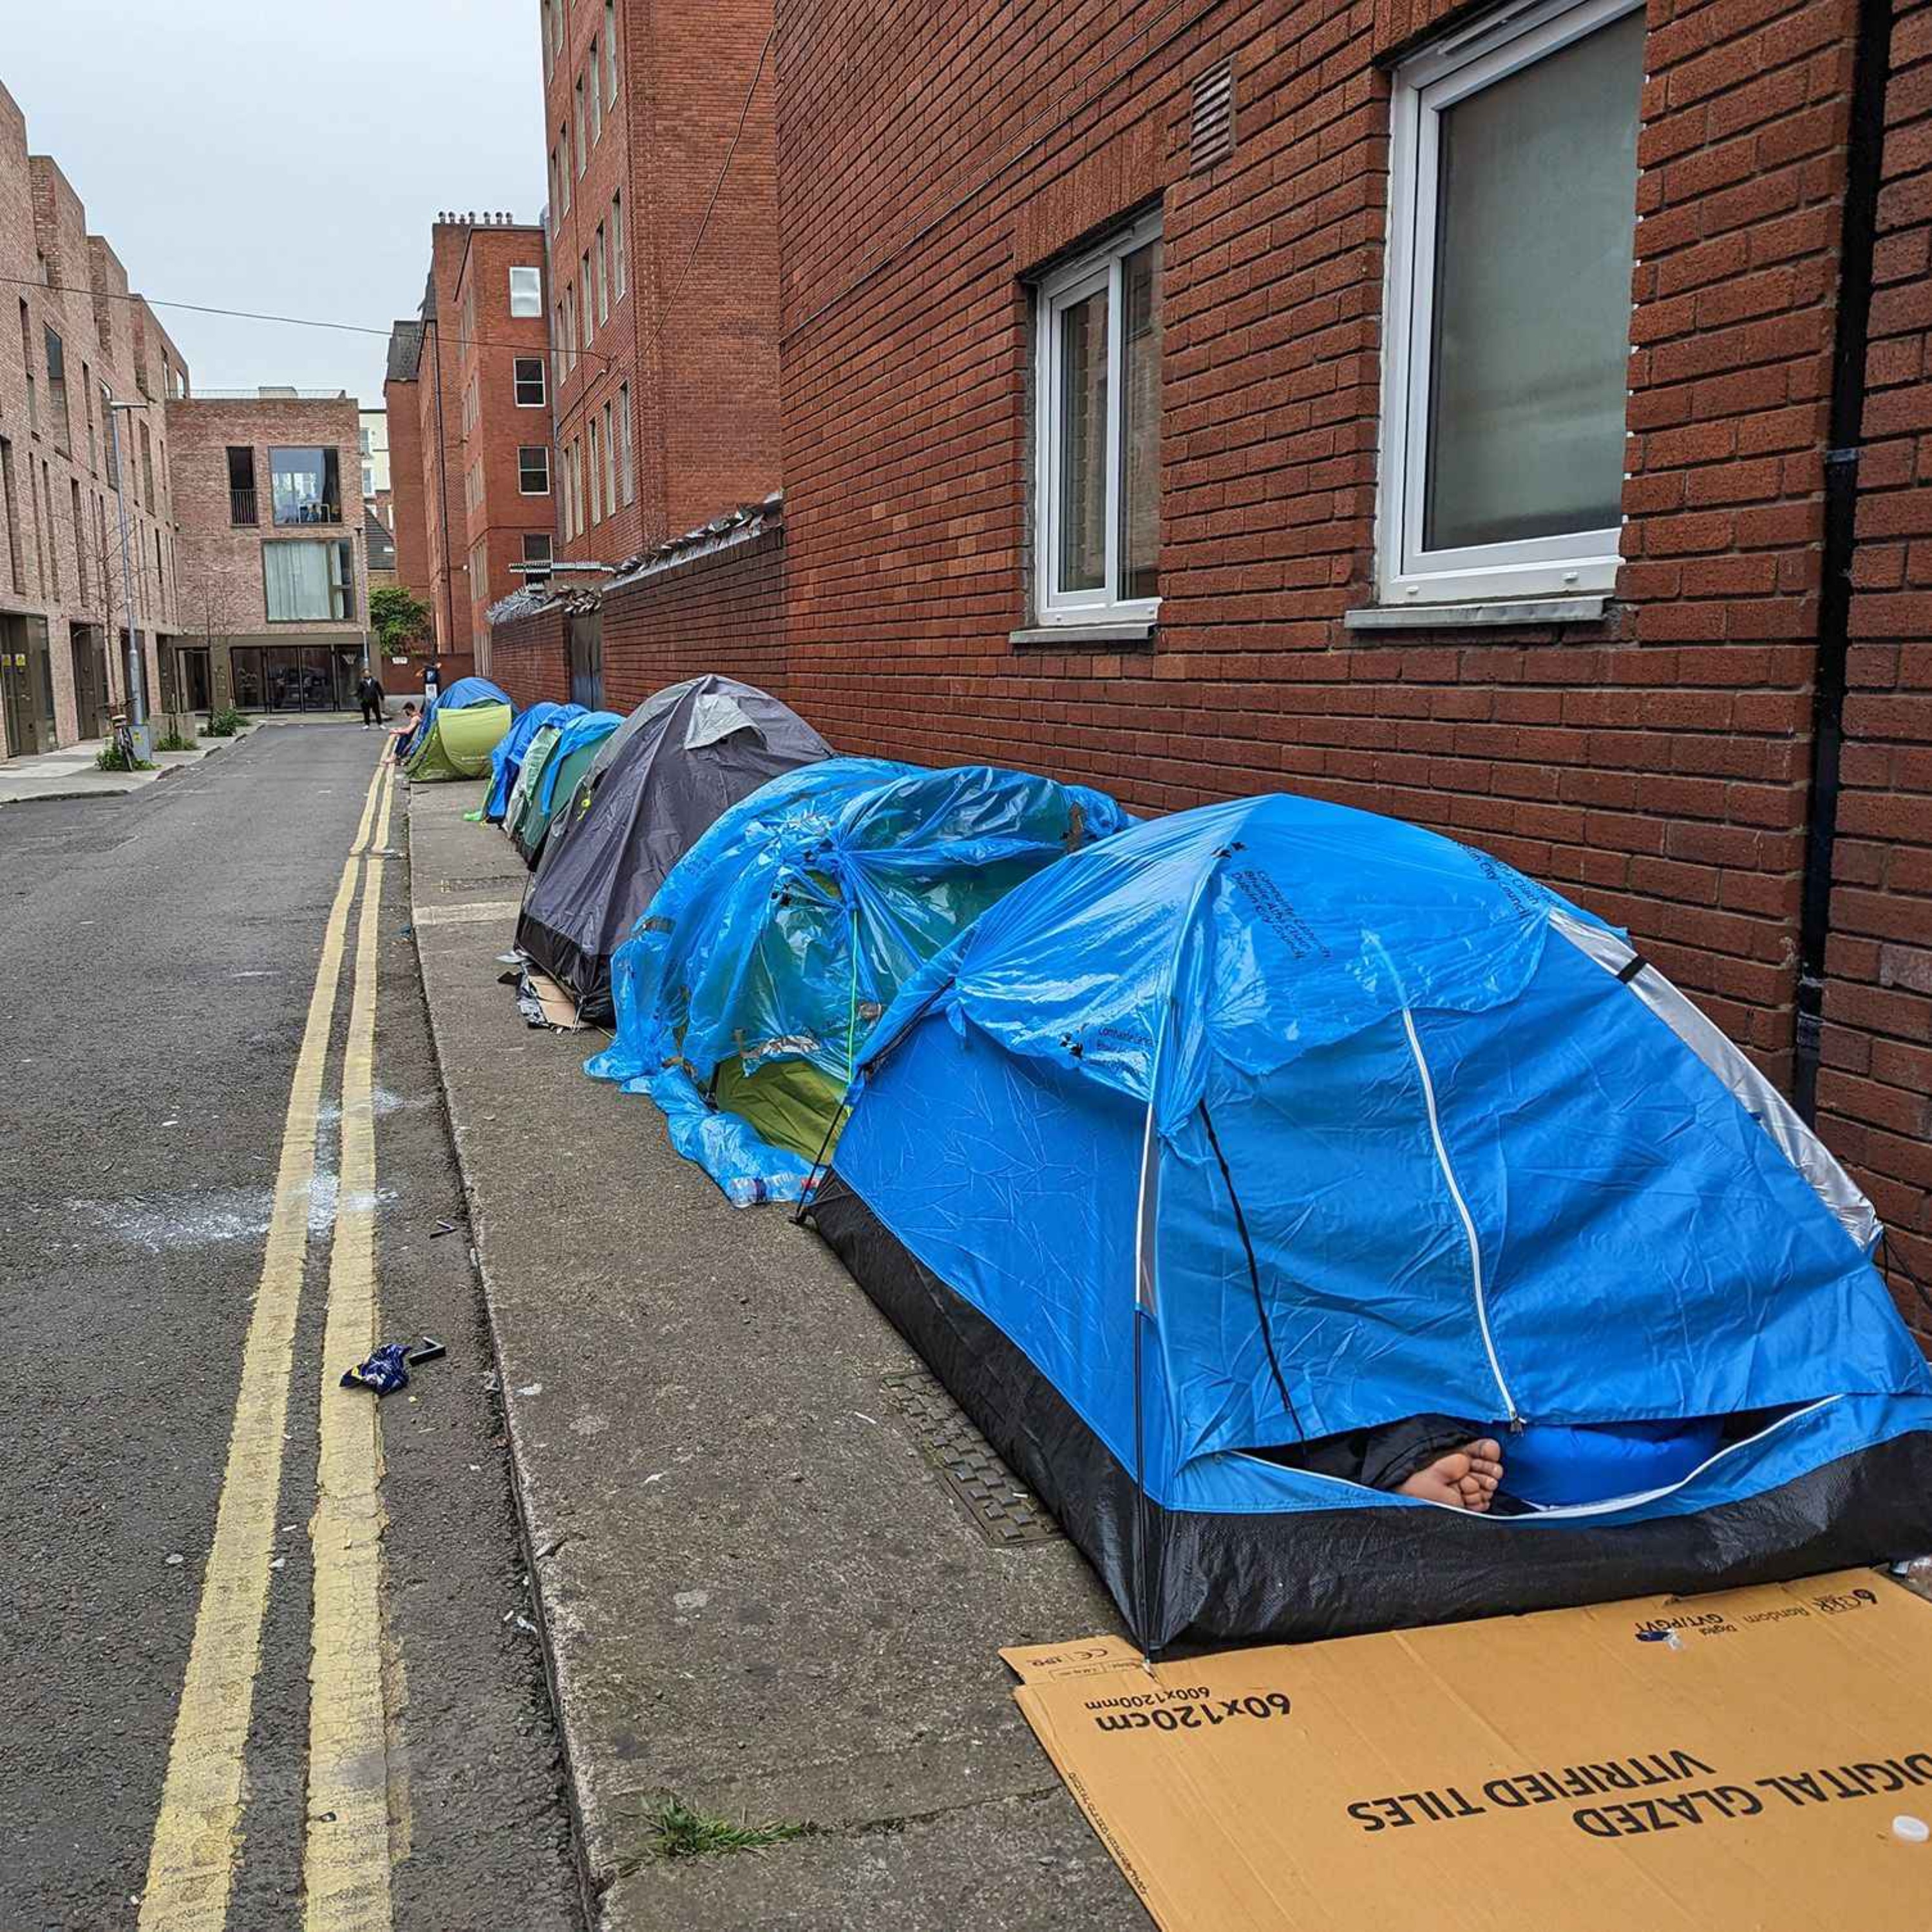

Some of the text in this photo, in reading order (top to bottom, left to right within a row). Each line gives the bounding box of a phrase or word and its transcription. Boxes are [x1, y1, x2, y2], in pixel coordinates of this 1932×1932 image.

[1743, 1607, 1809, 1624] Random
[1084, 1686, 1211, 1710] 600x1200mm
[1095, 1692, 1291, 1731] 60x120cm
[1347, 1750, 1717, 1832] VITRIFIED TILES
[1572, 1752, 1932, 1837] DIGITAL GLAZED
